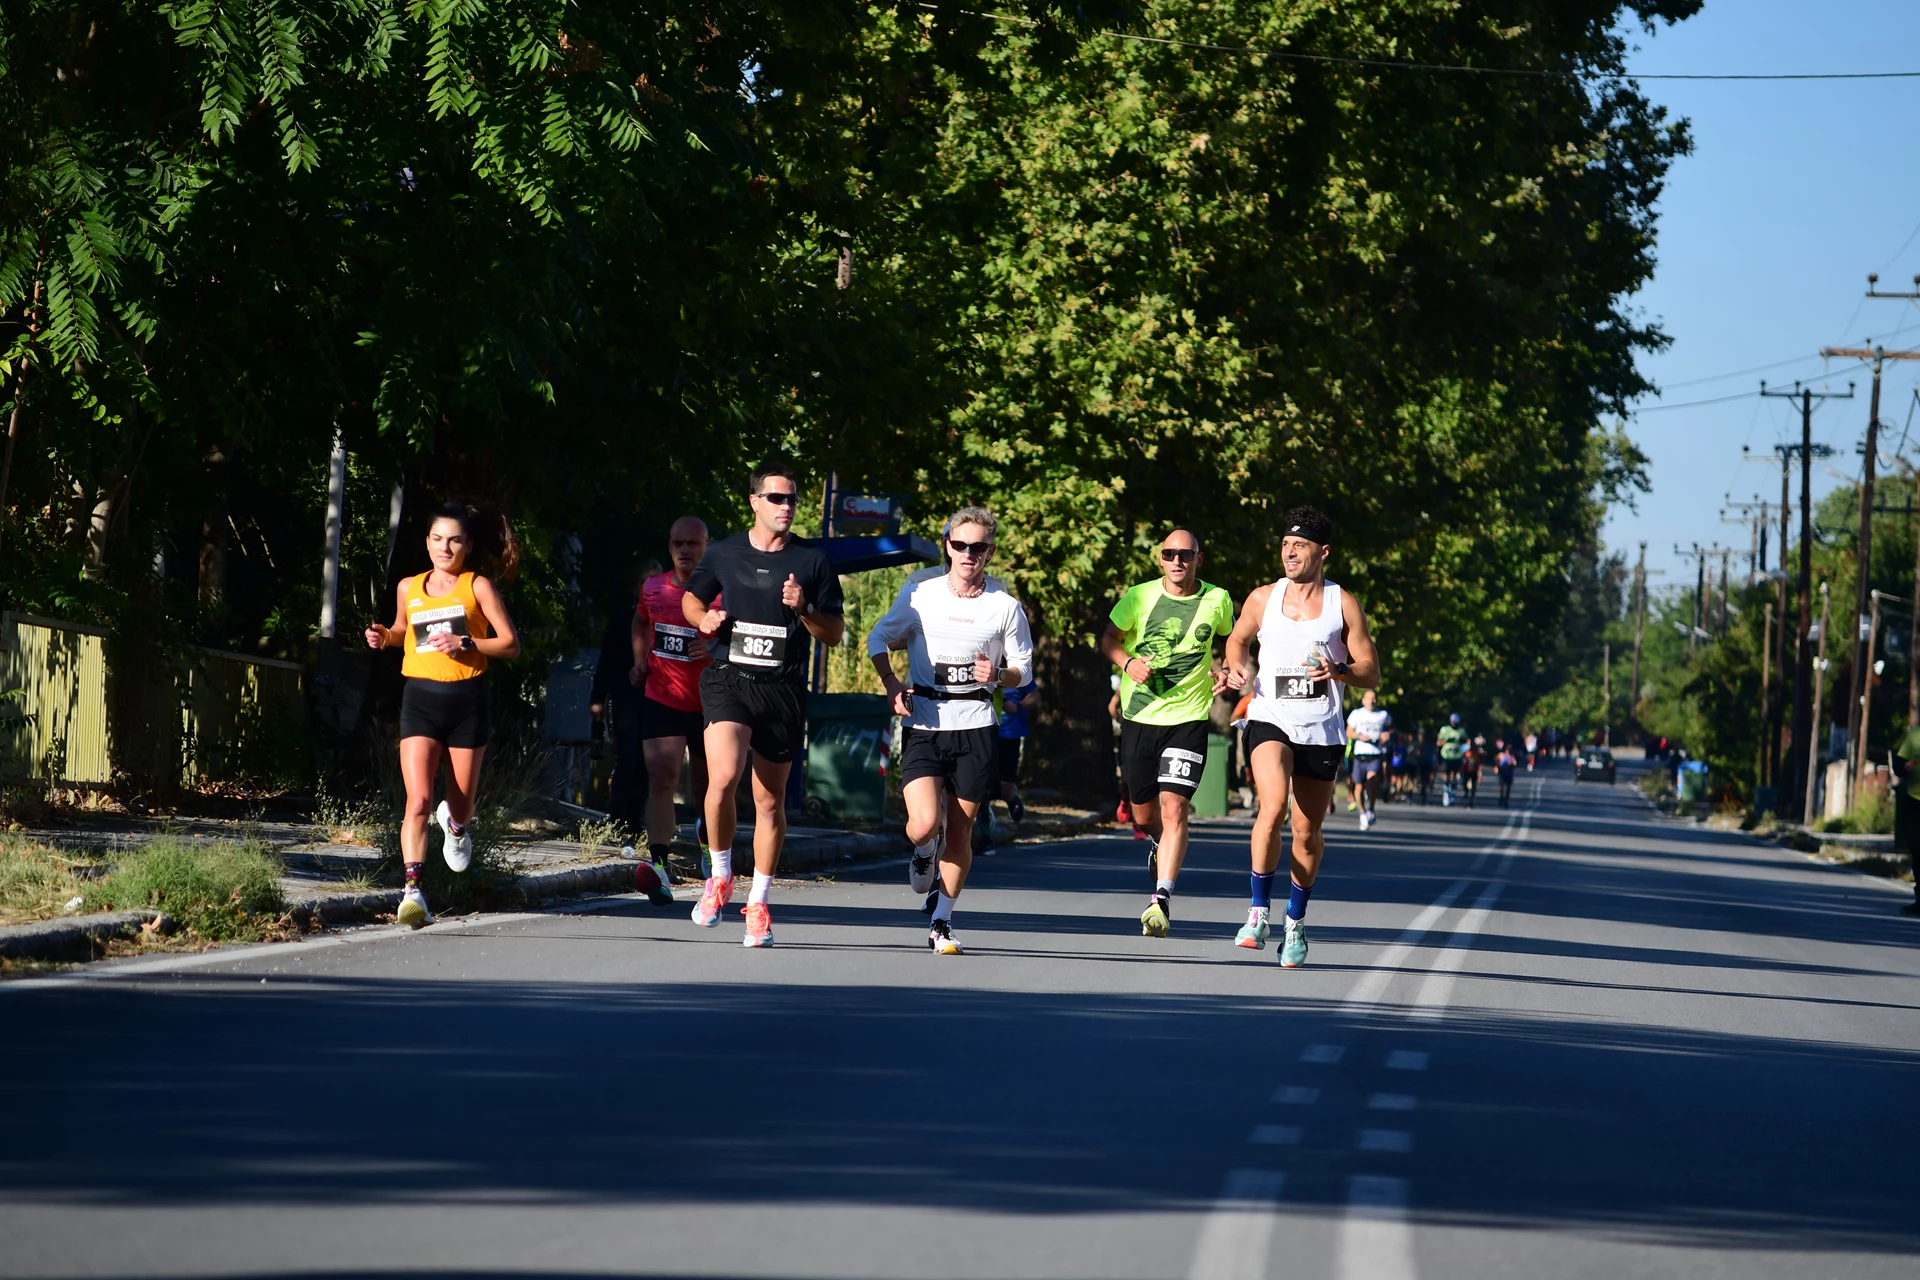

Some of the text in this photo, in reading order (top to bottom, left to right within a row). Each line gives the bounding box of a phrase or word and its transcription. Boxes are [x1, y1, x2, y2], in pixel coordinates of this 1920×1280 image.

[413, 607, 463, 621] step step step
[948, 616, 975, 624] saucony
[669, 626, 682, 634] step
[751, 625, 767, 634] step
[769, 627, 786, 636] step
[663, 636, 683, 652] 133
[743, 637, 774, 656] 362
[936, 653, 952, 662] step
[954, 655, 970, 663] step
[947, 666, 976, 682] 363
[1276, 666, 1308, 675] step ste
[1288, 679, 1314, 695] 341
[1168, 759, 1191, 777] 126
